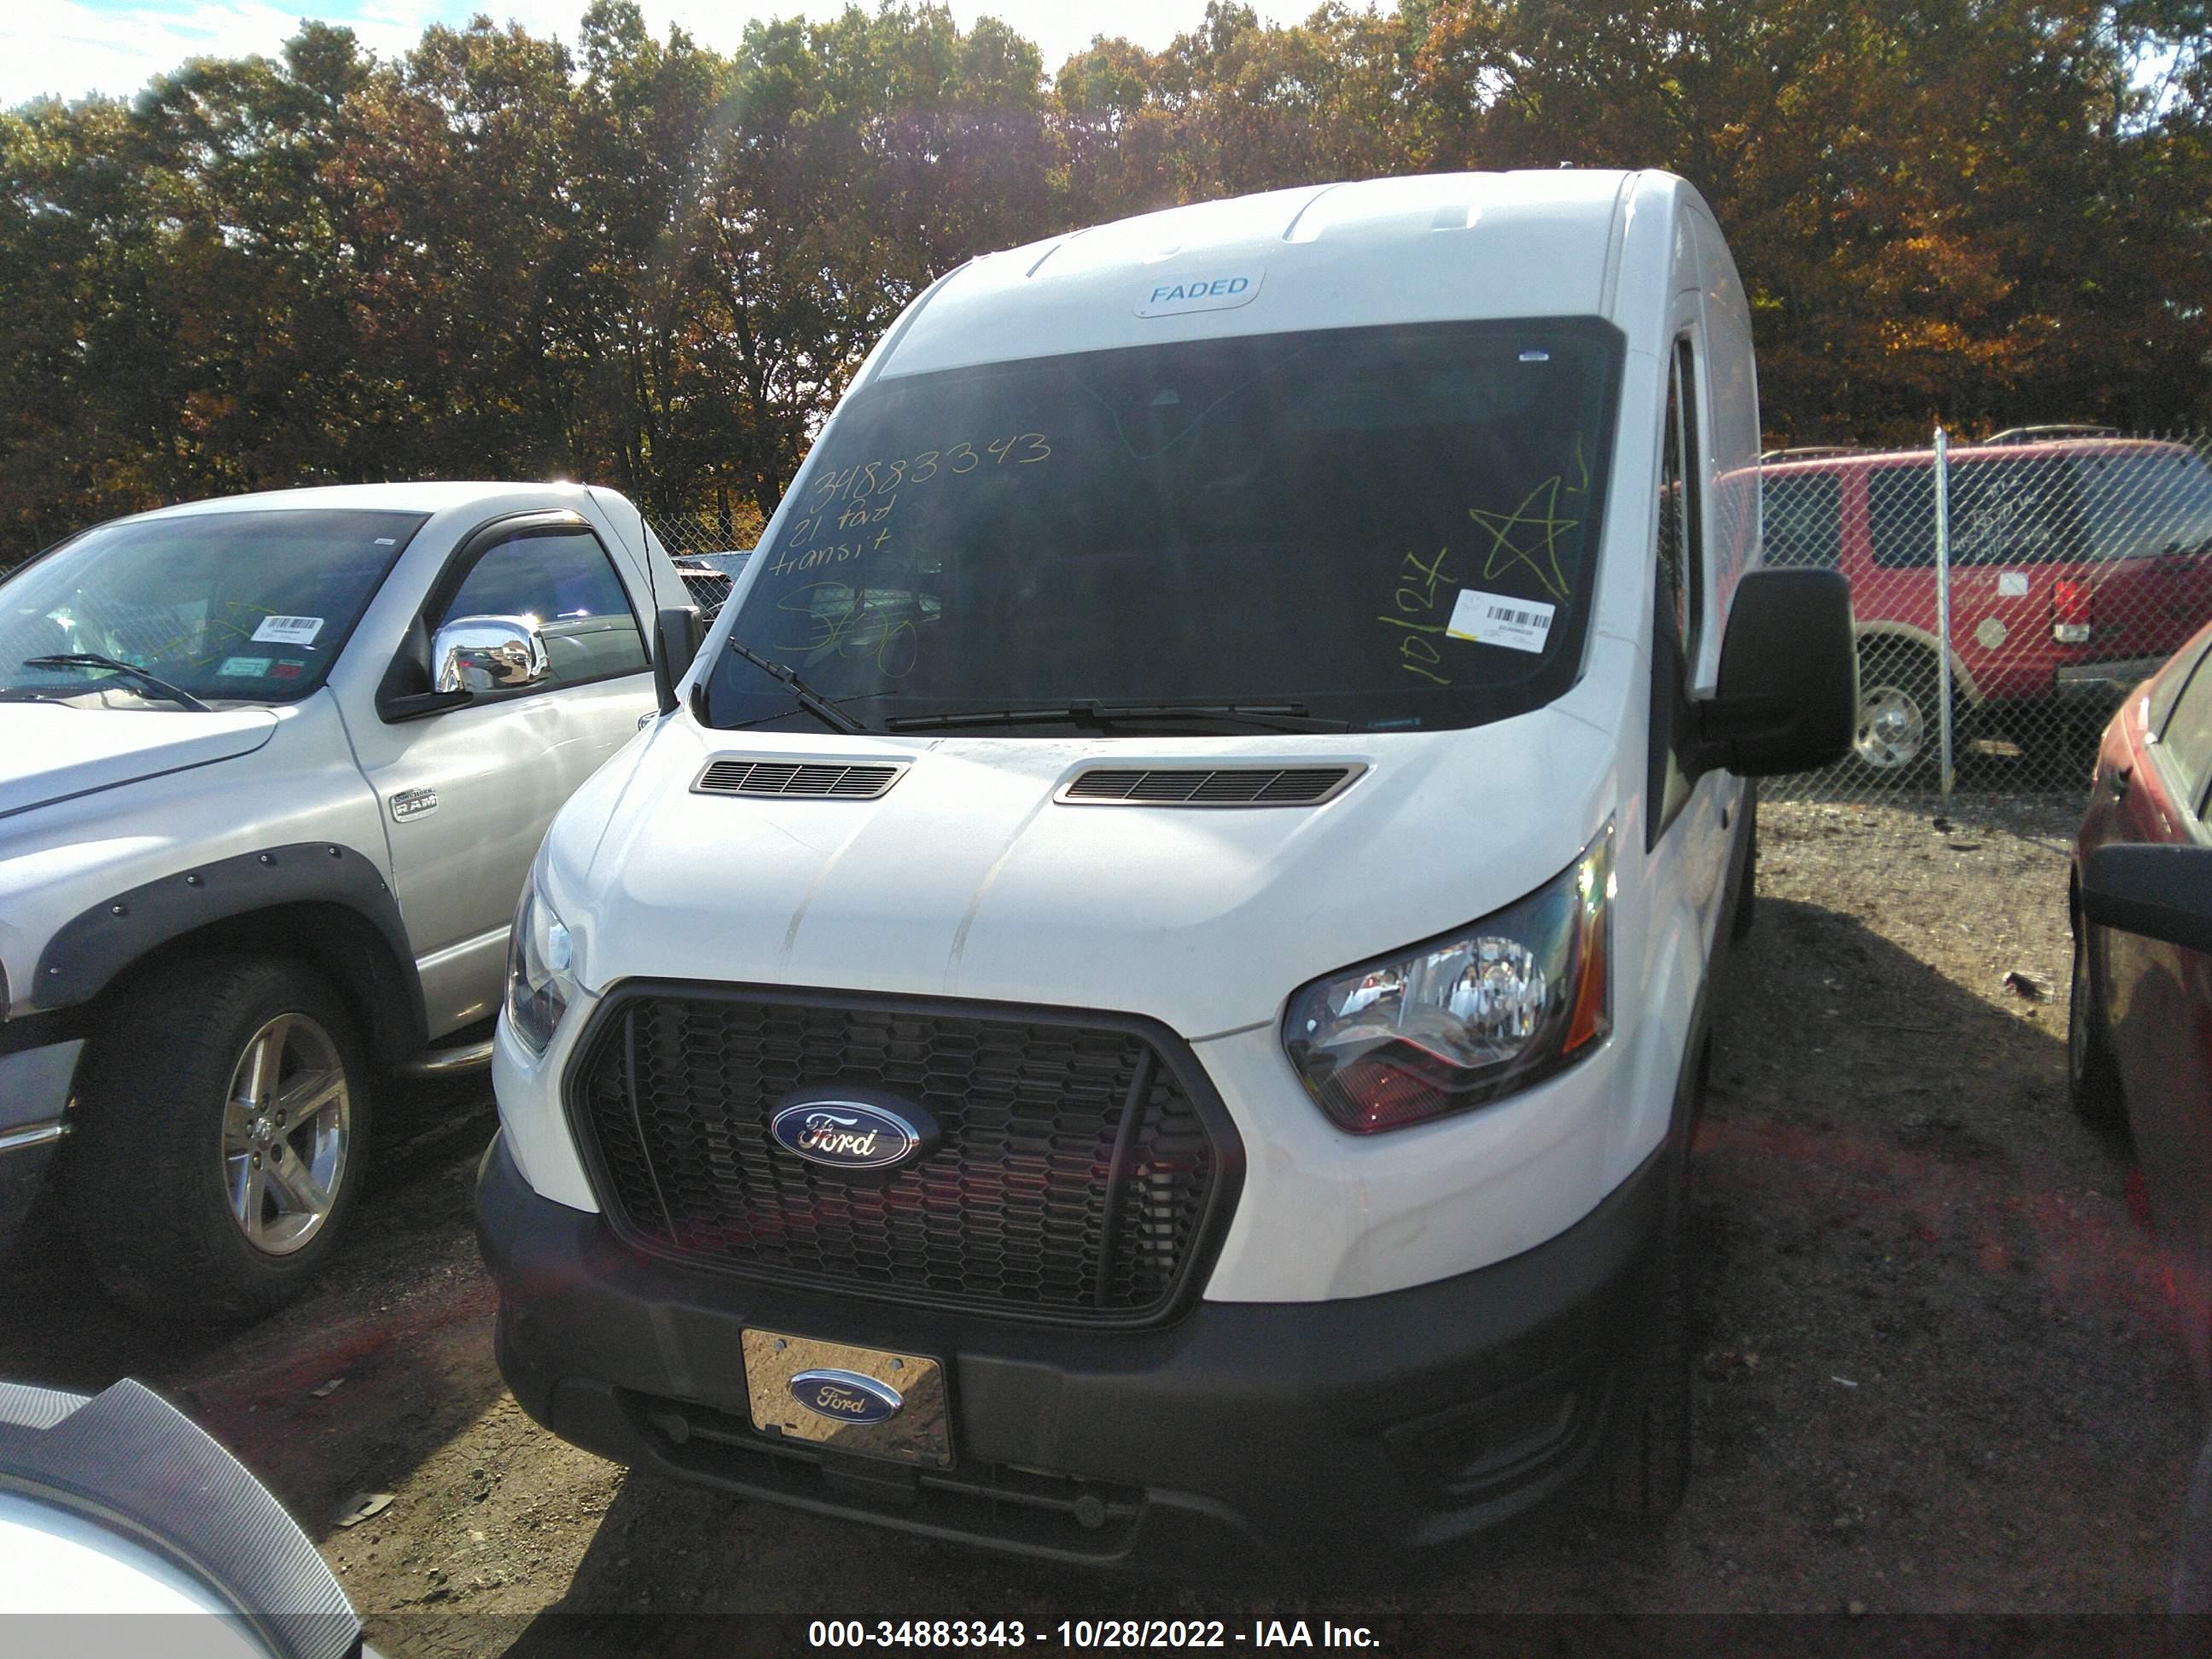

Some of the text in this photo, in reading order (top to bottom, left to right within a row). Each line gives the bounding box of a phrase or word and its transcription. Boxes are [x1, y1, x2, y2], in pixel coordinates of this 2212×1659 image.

[1150, 276, 1249, 303] FADED
[810, 433, 1052, 514] 34883343
[789, 515, 821, 548] 21
[770, 527, 891, 577] transit
[396, 794, 437, 815] RAM
[798, 1112, 879, 1156] Ford
[816, 1385, 866, 1415] Ford
